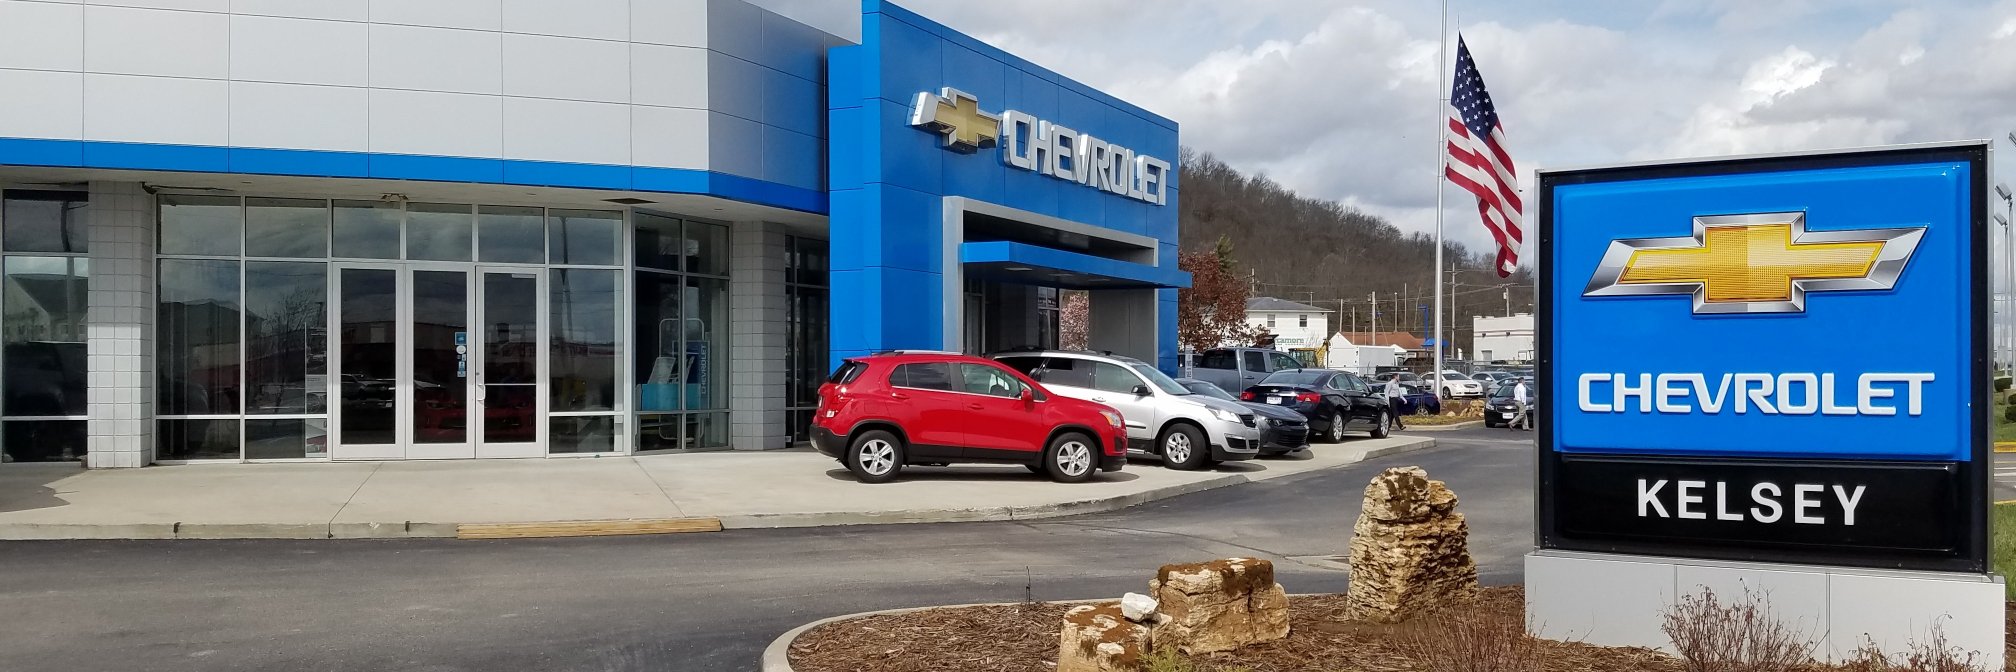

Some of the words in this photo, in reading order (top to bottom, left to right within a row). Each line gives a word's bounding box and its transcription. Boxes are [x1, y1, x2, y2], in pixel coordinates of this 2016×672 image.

[1003, 110, 1170, 206] CHEVROLET
[1578, 373, 1935, 416] CHEVROLET
[1637, 479, 1866, 525] KELSEY
